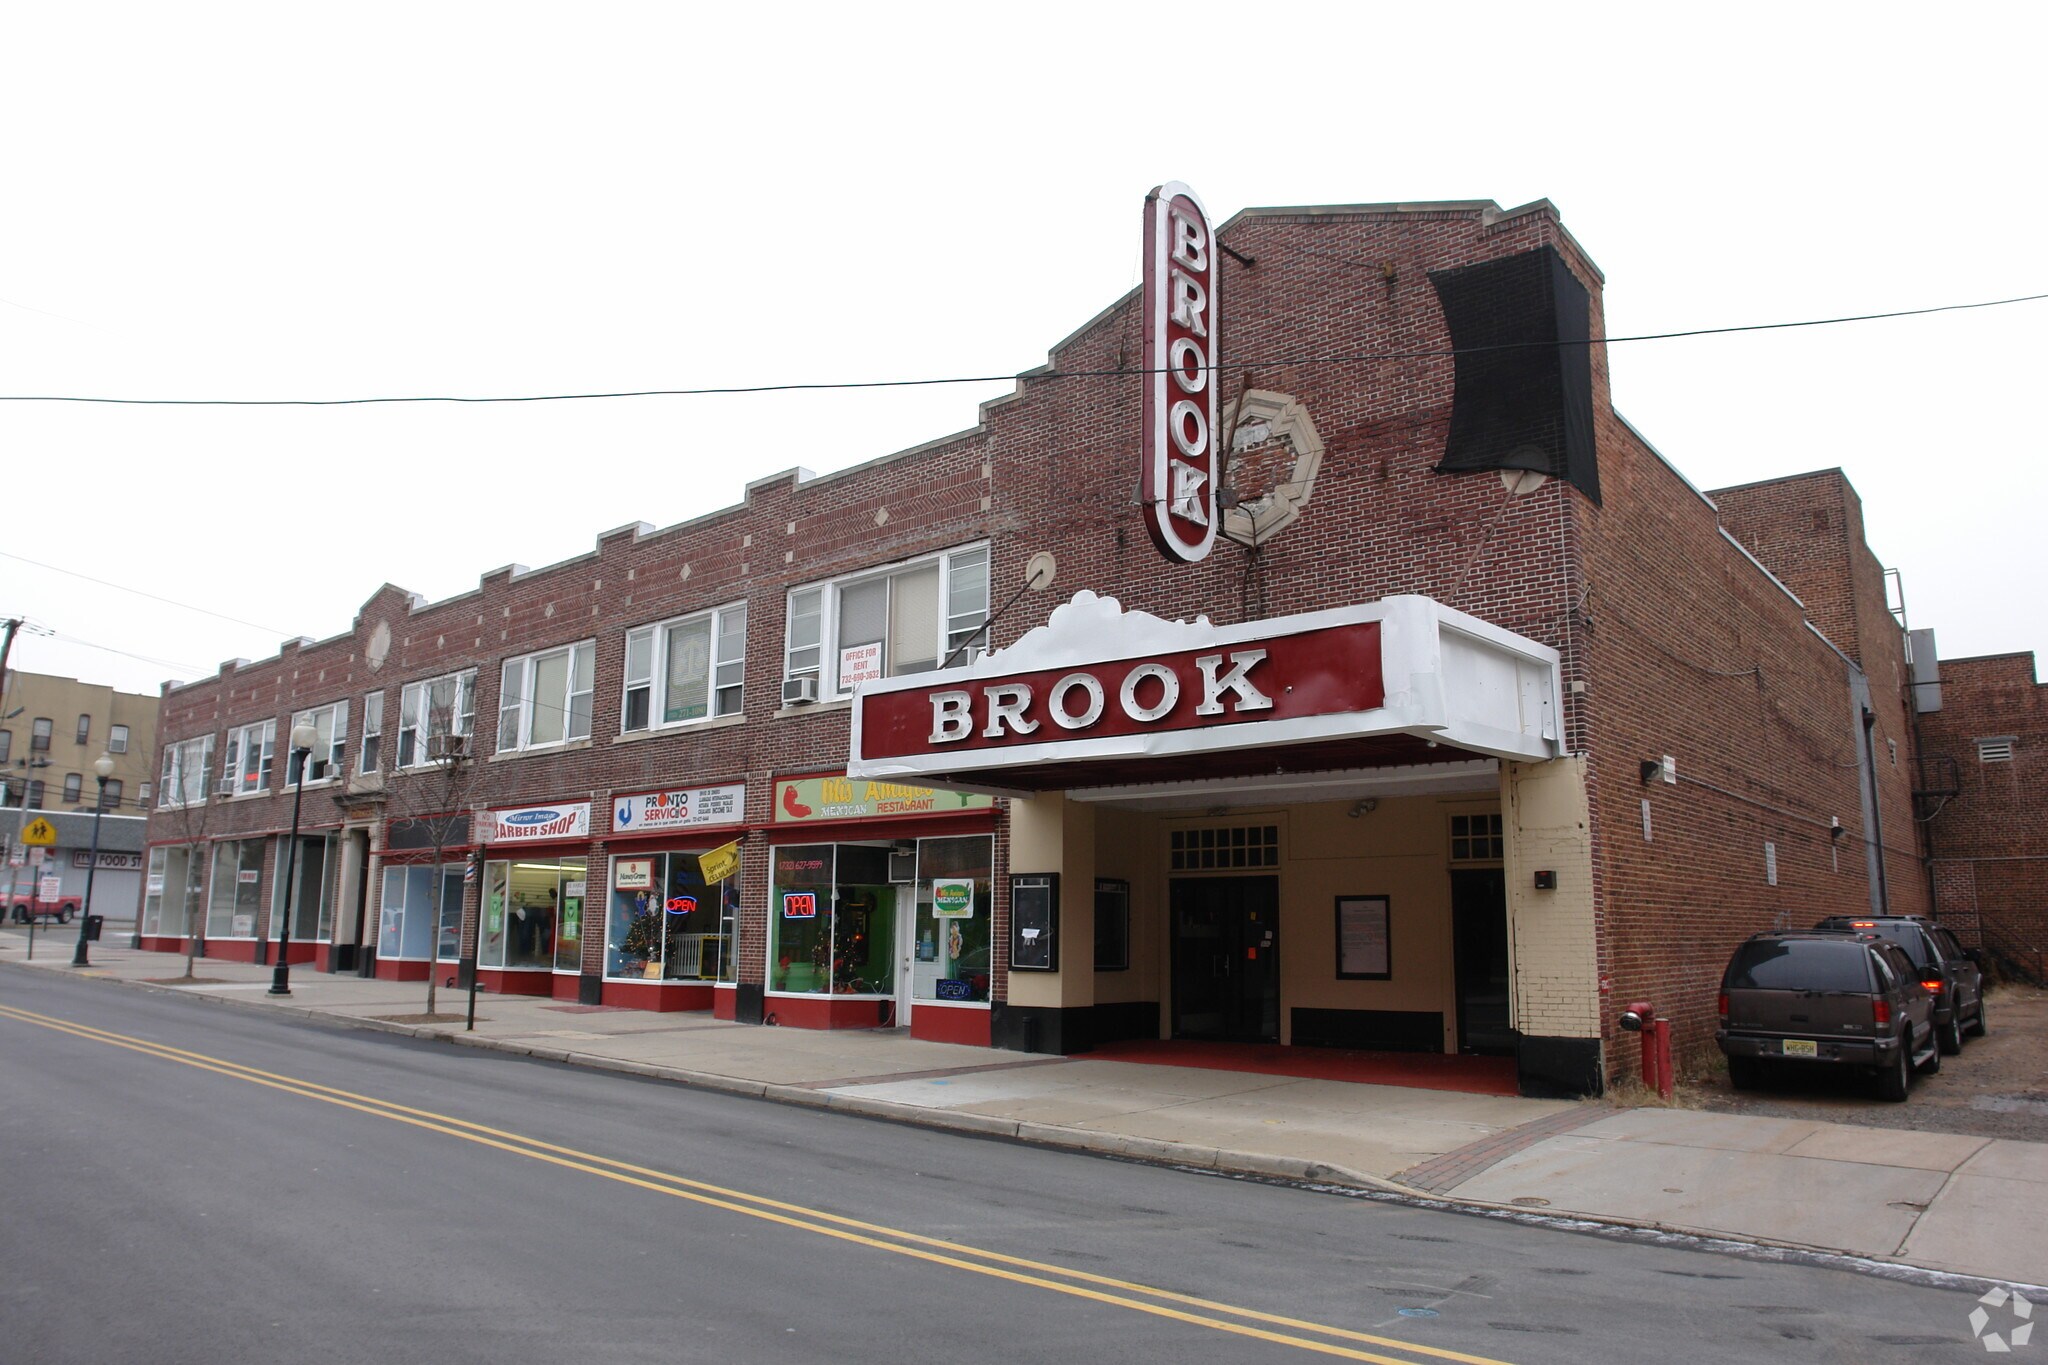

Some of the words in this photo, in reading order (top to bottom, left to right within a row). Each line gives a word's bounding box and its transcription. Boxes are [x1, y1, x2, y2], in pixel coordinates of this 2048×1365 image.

[1170, 208, 1208, 526] BROOK
[845, 650, 865, 661] OFFICE
[866, 648, 876, 658] FOR
[853, 661, 868, 671] RENT
[928, 648, 1274, 745] BROOK
[821, 777, 853, 805] Mis
[645, 793, 688, 808] PRONTO
[644, 806, 688, 821] SERVICIO
[821, 804, 867, 817] MEXICAN
[877, 799, 934, 813] RESTAURANT
[482, 812, 490, 820] NO
[508, 814, 532, 823] Mirror
[534, 812, 556, 821] Image
[540, 812, 577, 836] SHOP
[99, 854, 128, 866] FOOD
[706, 860, 727, 874] Sprint
[619, 872, 647, 881] MoneyGram
[666, 898, 697, 912] OPEN
[786, 895, 815, 916] OPEN
[941, 984, 966, 995] OPEN
